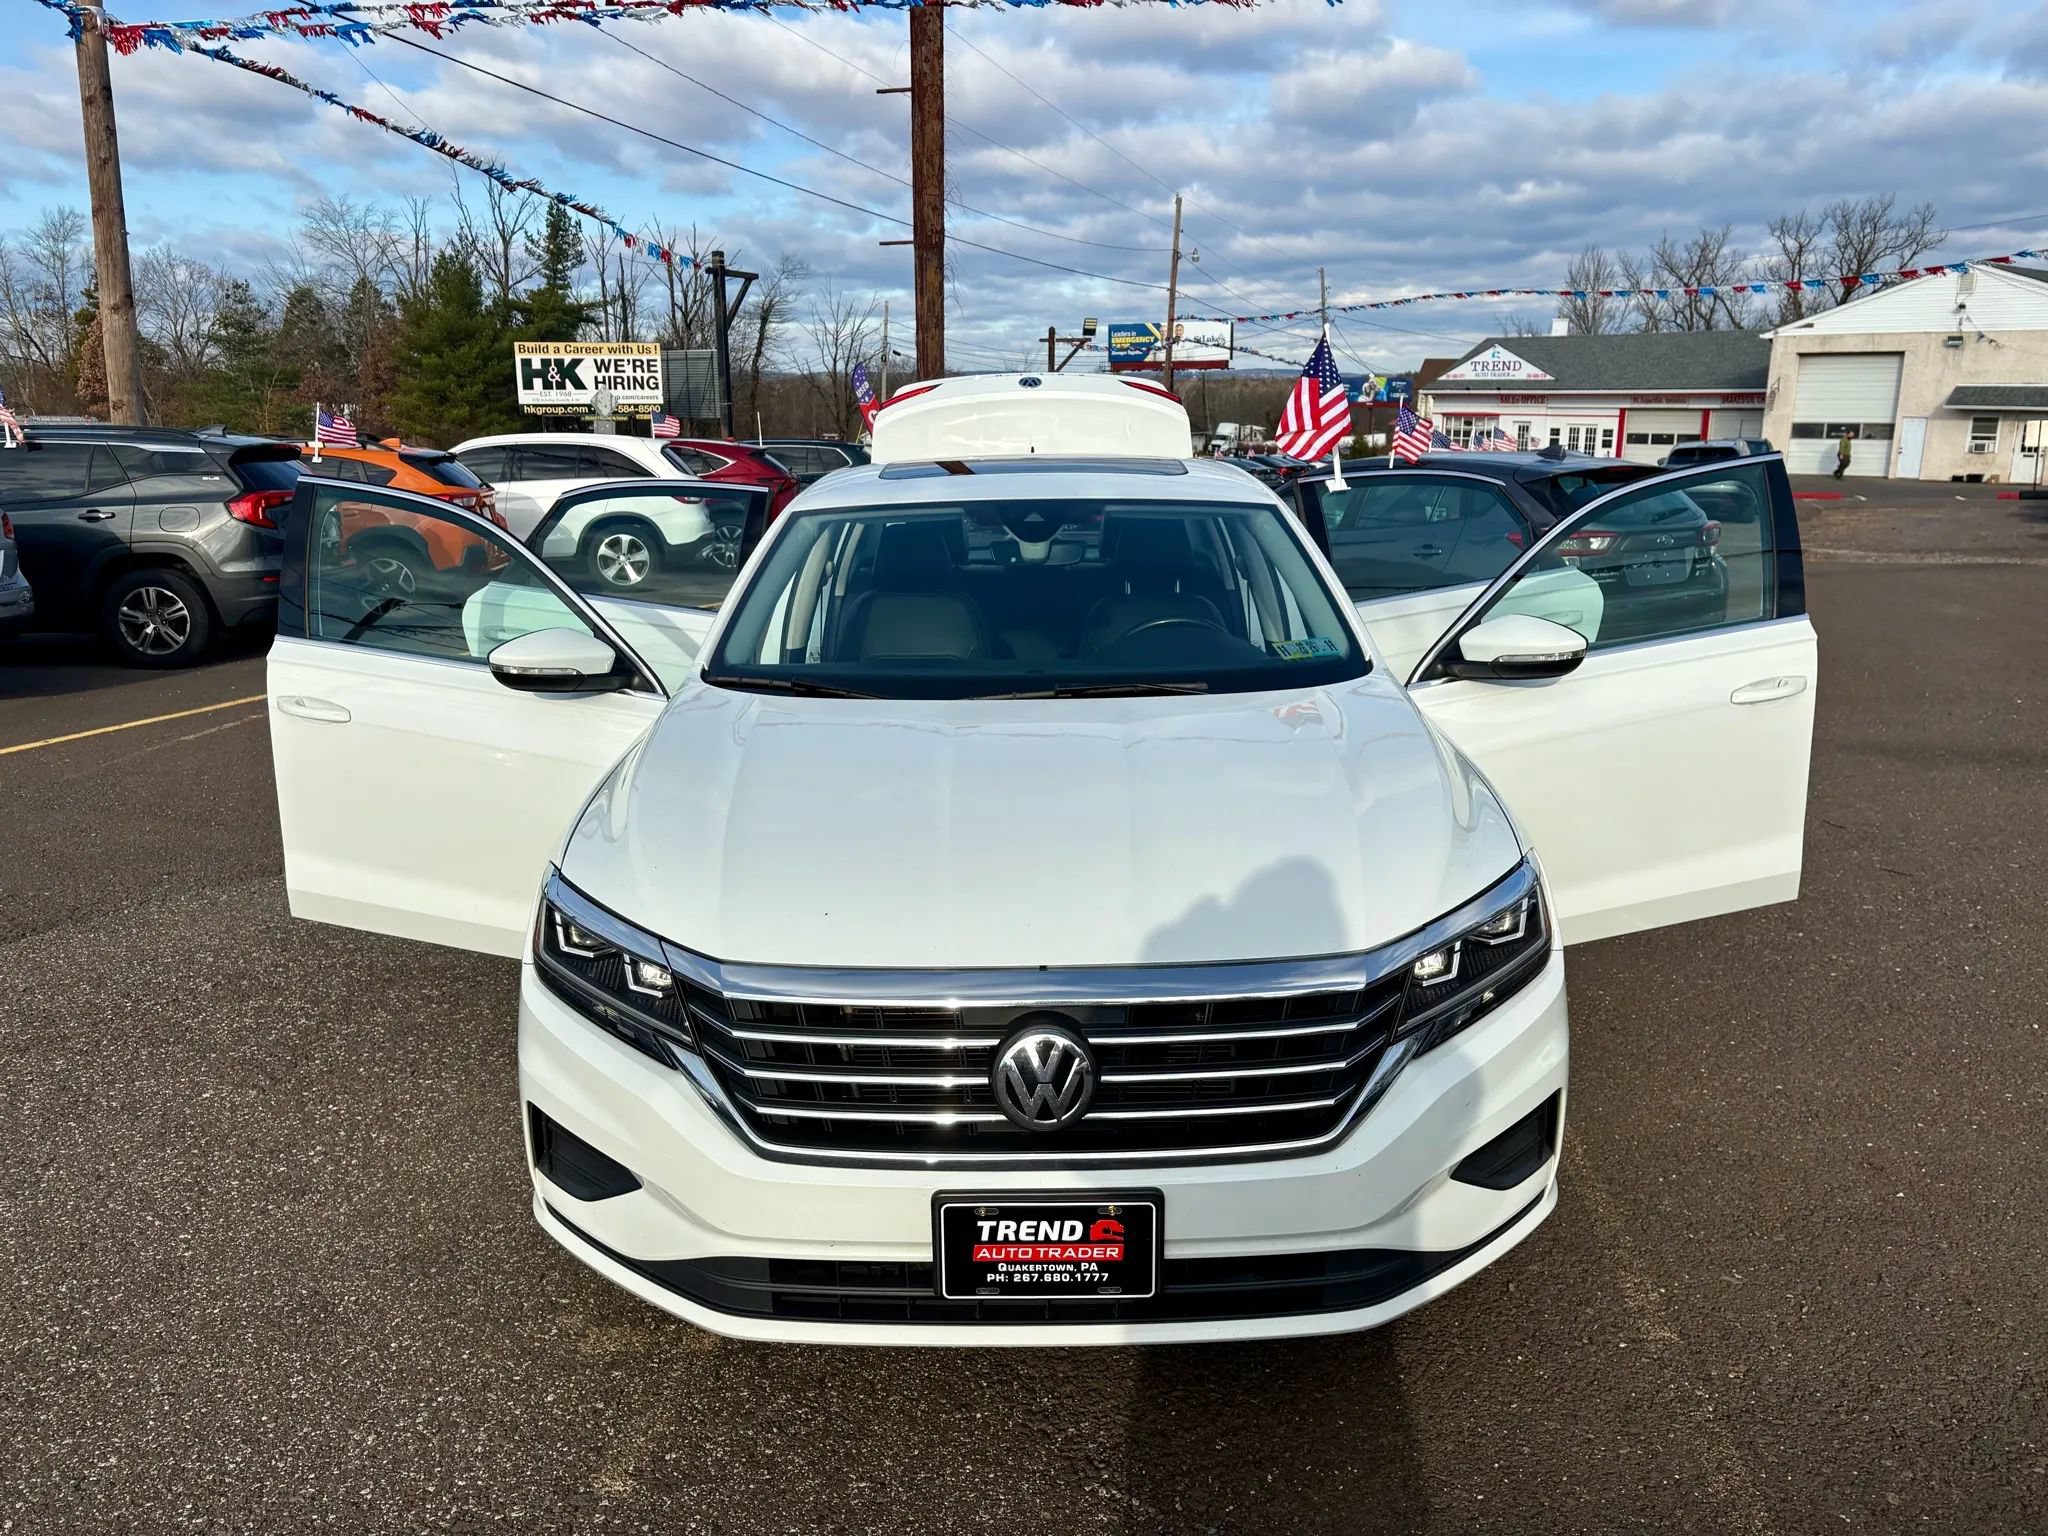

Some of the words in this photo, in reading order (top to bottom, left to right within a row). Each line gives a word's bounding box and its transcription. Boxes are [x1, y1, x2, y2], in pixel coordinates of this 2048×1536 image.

[1111, 336, 1155, 344] EMERGENCY
[518, 344, 549, 354] Build
[553, 346, 560, 354] a
[564, 344, 602, 354] Career
[604, 344, 633, 354] with
[593, 358, 659, 374] WE'RE
[1470, 360, 1522, 372] TREND
[520, 358, 588, 390] H&K
[594, 375, 660, 391] HIRING
[856, 381, 870, 397] USED
[524, 405, 589, 416] hkgroup.com
[614, 404, 661, 414] -584-8500
[976, 1220, 1084, 1241] TREND
[976, 1247, 1032, 1259] AUTO
[1036, 1247, 1120, 1259] TRADER
[1080, 1262, 1099, 1272] PA
[986, 1273, 1009, 1282] PH:
[1013, 1272, 1110, 1282] 267.680.1777
